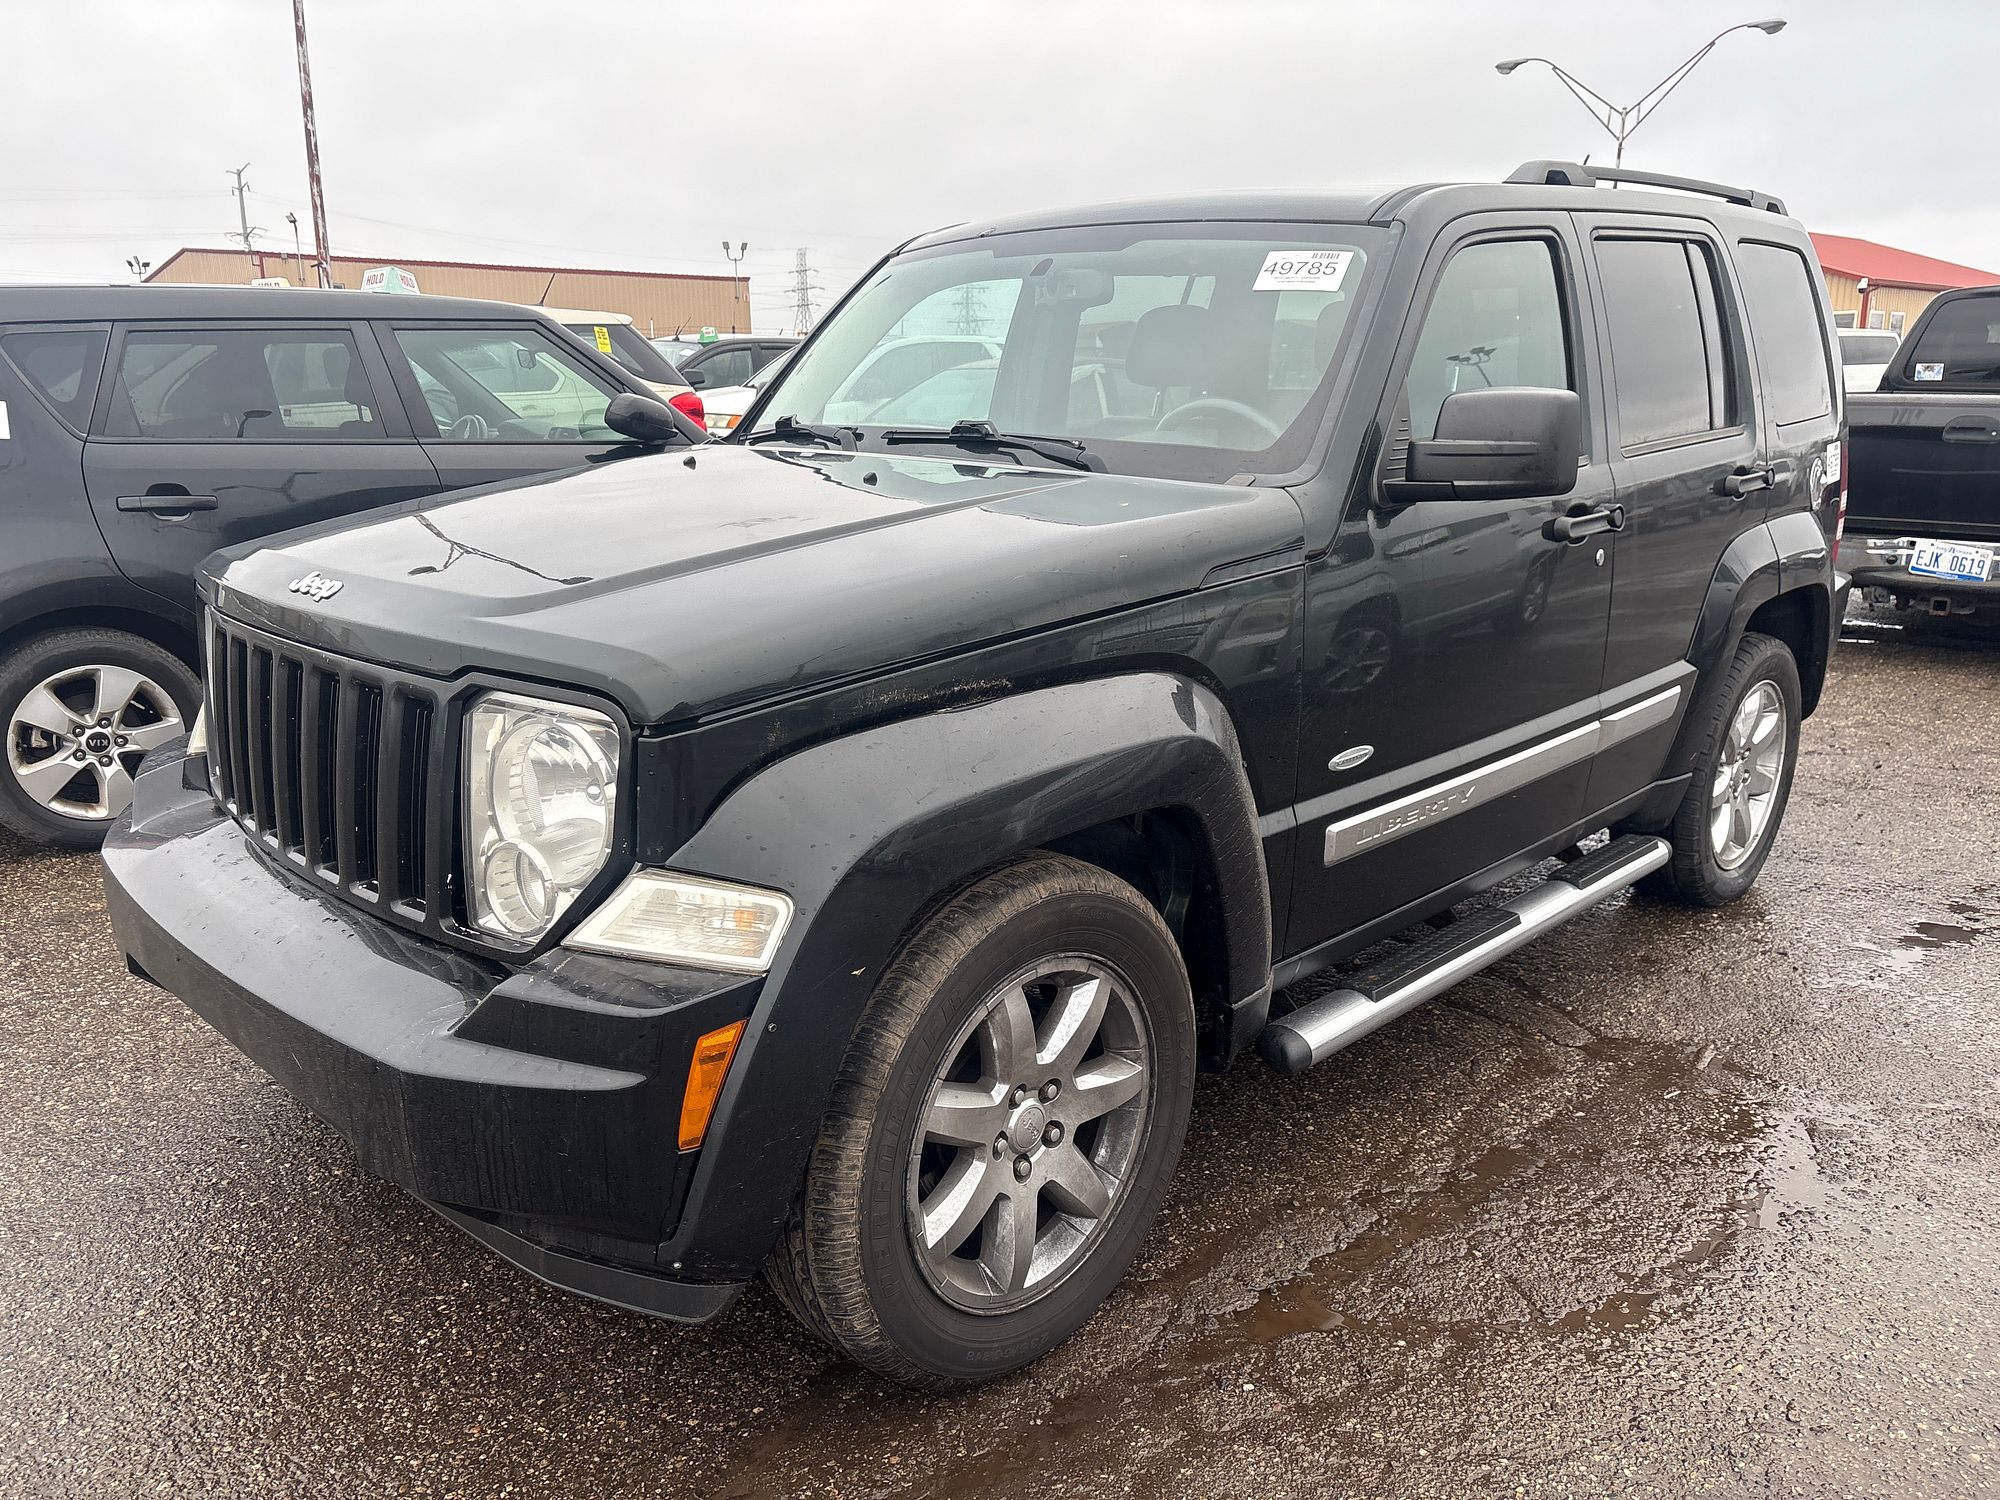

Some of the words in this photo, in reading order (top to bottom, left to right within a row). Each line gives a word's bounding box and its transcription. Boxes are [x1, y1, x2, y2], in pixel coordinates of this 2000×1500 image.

[1263, 261, 1338, 275] 49785
[366, 272, 384, 286] HOLD
[1916, 549, 1943, 569] EJK
[1949, 555, 1985, 576] 0619
[288, 570, 344, 602] Jeep
[88, 739, 108, 747] KIA
[1355, 784, 1477, 845] LIBERTY
